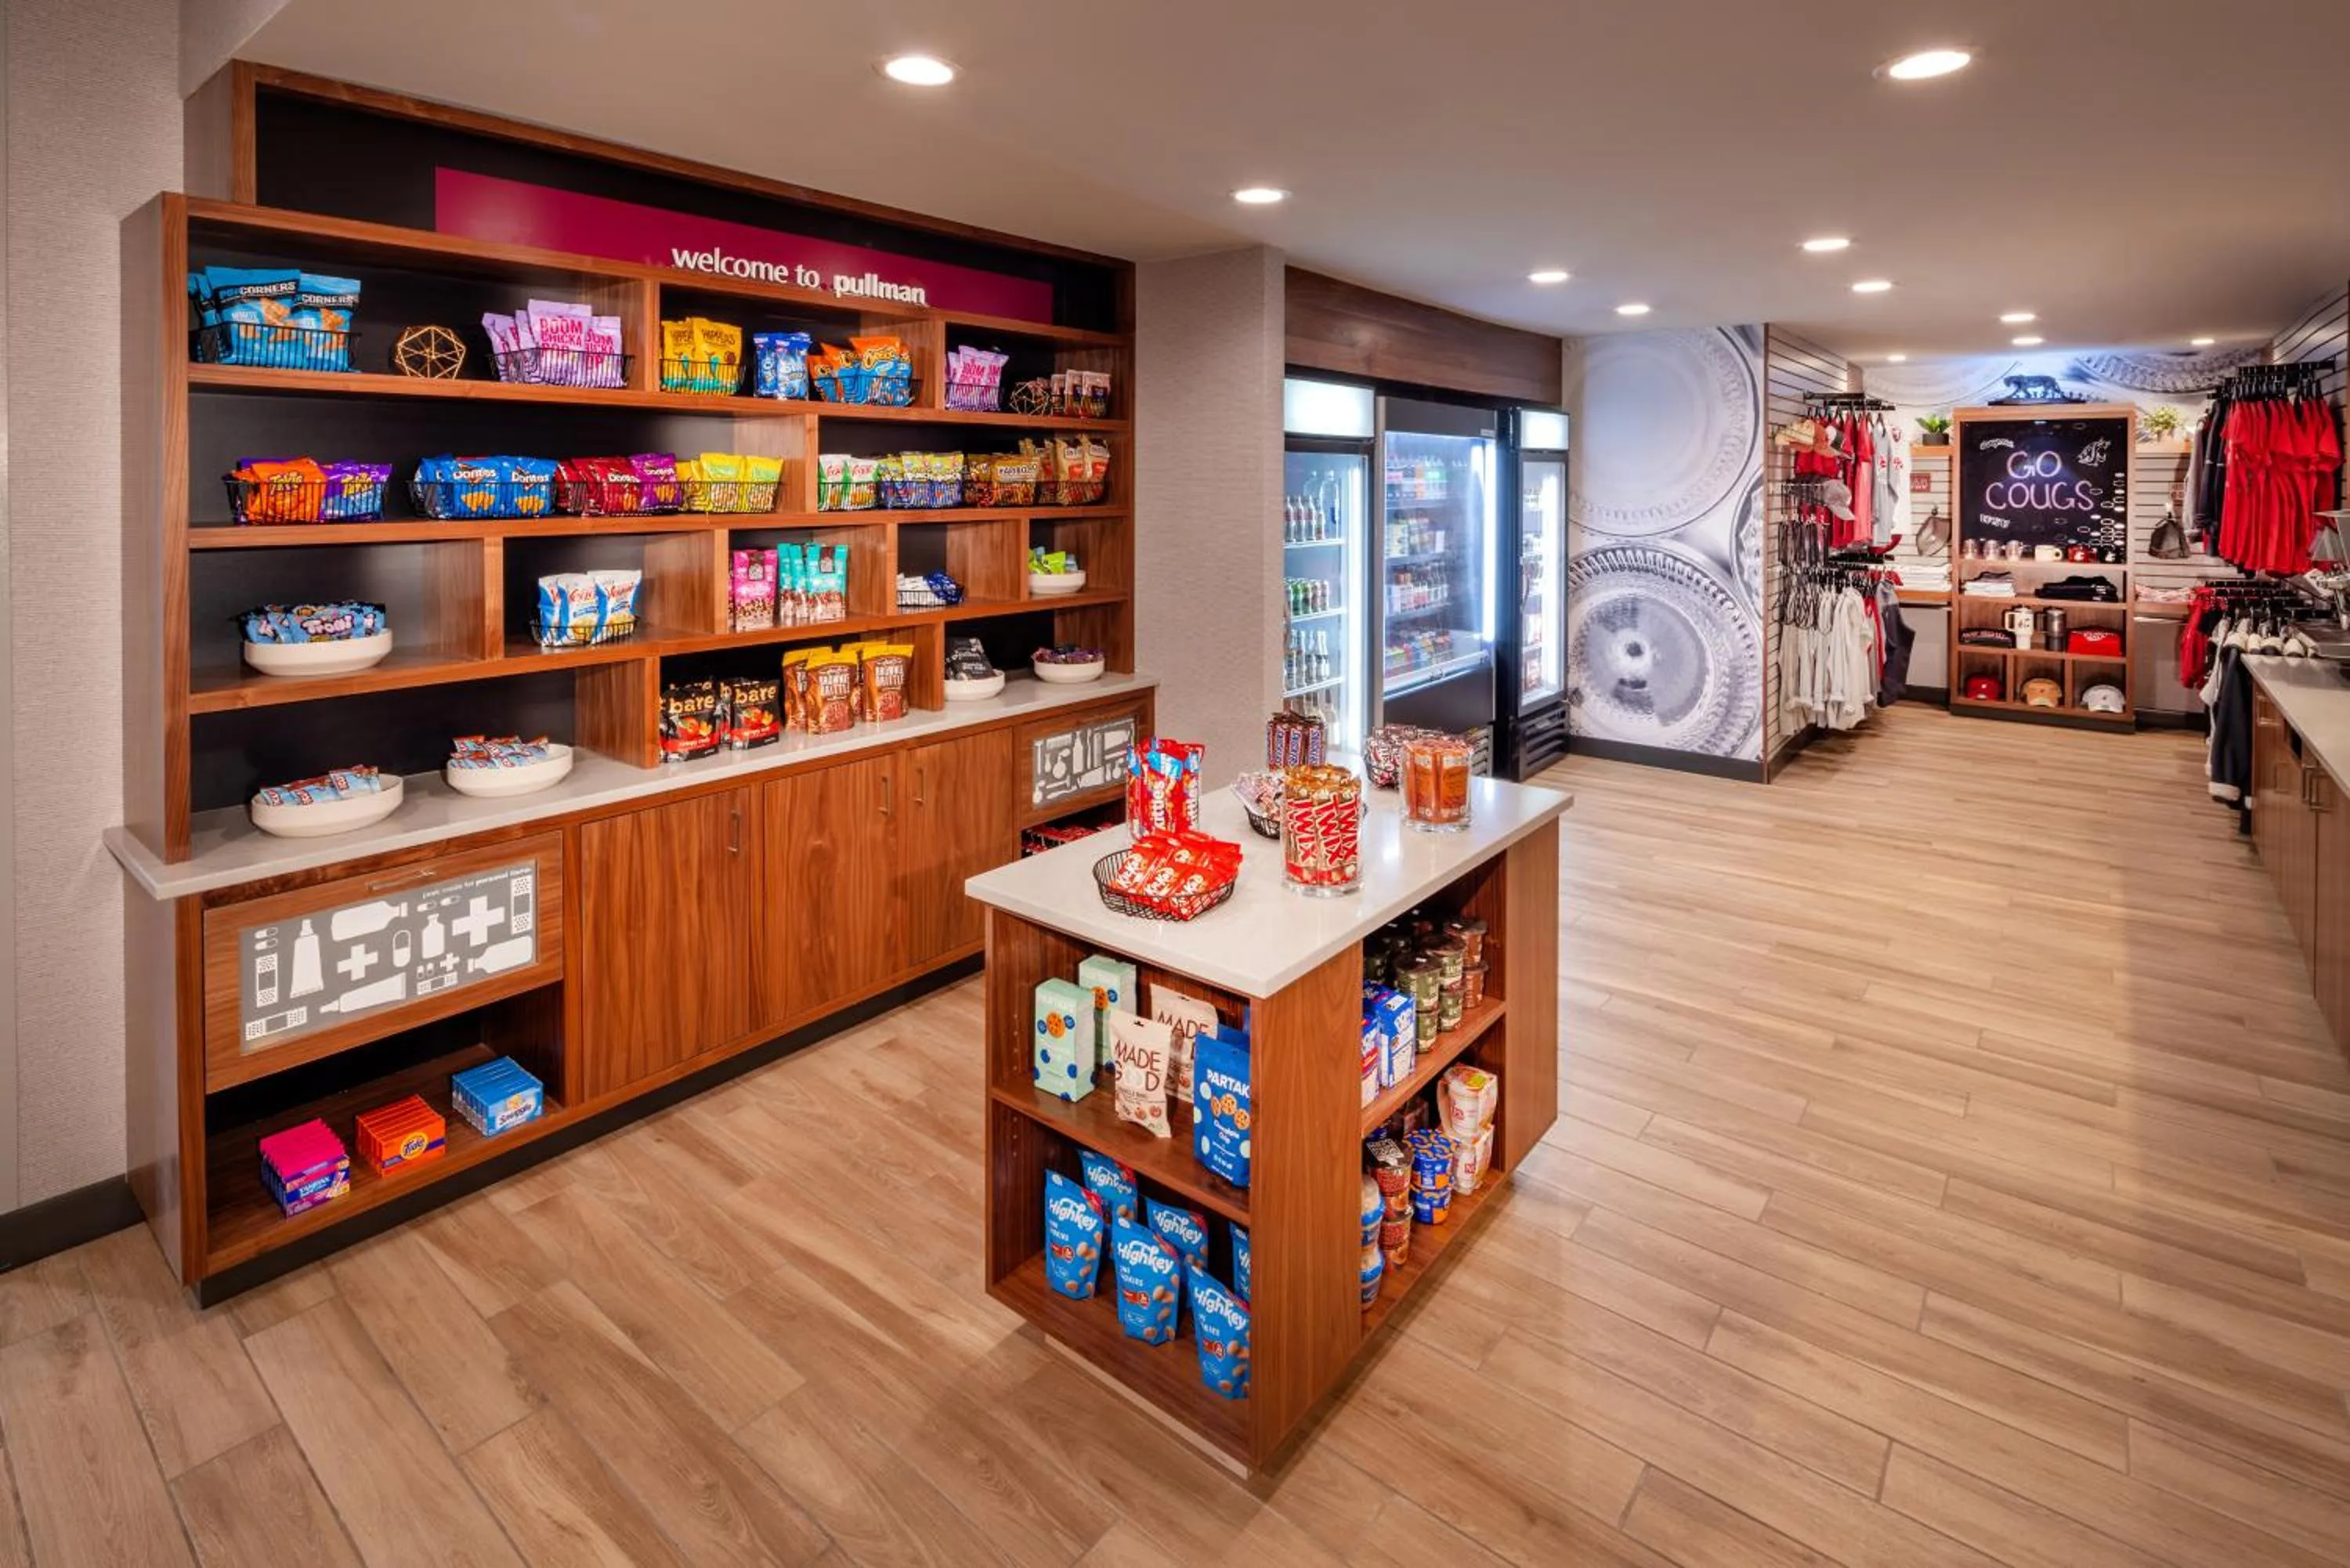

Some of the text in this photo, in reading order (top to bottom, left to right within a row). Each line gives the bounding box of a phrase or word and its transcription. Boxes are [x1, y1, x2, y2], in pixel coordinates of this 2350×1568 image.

[671, 247, 927, 304] welcome to pullman
[540, 316, 584, 334] BOOM
[540, 330, 583, 347] CHICKA
[453, 467, 497, 480] Doritos
[511, 470, 549, 482] Doritos
[2005, 450, 2063, 479] GO
[1985, 480, 2095, 511] COUGS
[668, 694, 715, 714] bare
[736, 685, 777, 704] bare
[1287, 797, 1318, 864] TWIX
[1313, 792, 1343, 865] TWIX
[1115, 1039, 1162, 1072] MADE
[1206, 1069, 1250, 1099] PARTAK
[403, 1136, 425, 1157] Tide
